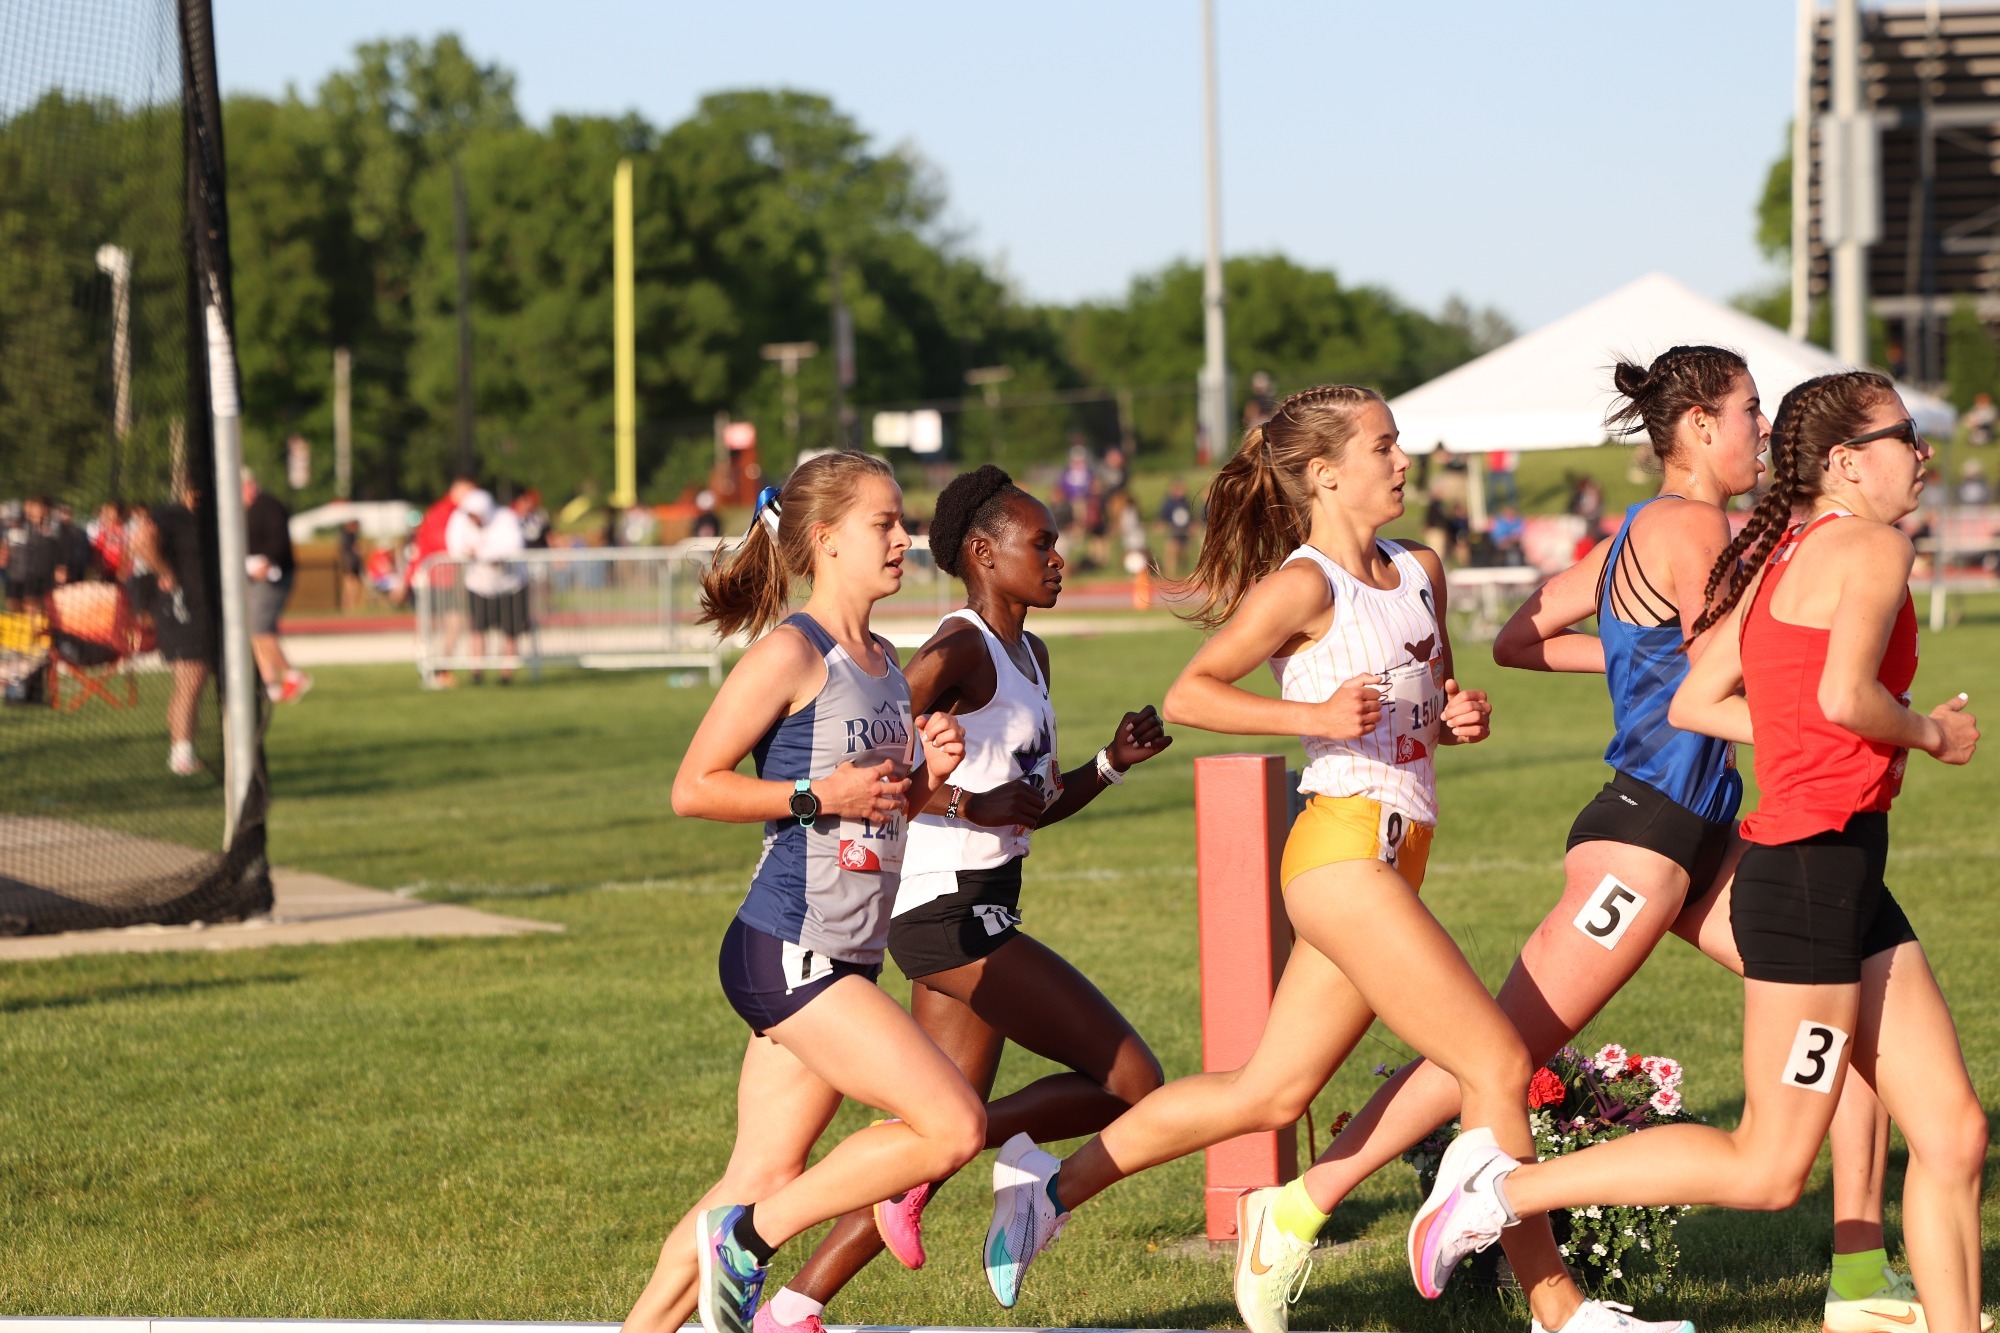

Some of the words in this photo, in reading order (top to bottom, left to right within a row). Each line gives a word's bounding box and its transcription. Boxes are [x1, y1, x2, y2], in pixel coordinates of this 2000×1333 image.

[1411, 694, 1439, 730] 1510
[1584, 884, 1636, 937] 5
[1794, 1027, 1834, 1085] 3
